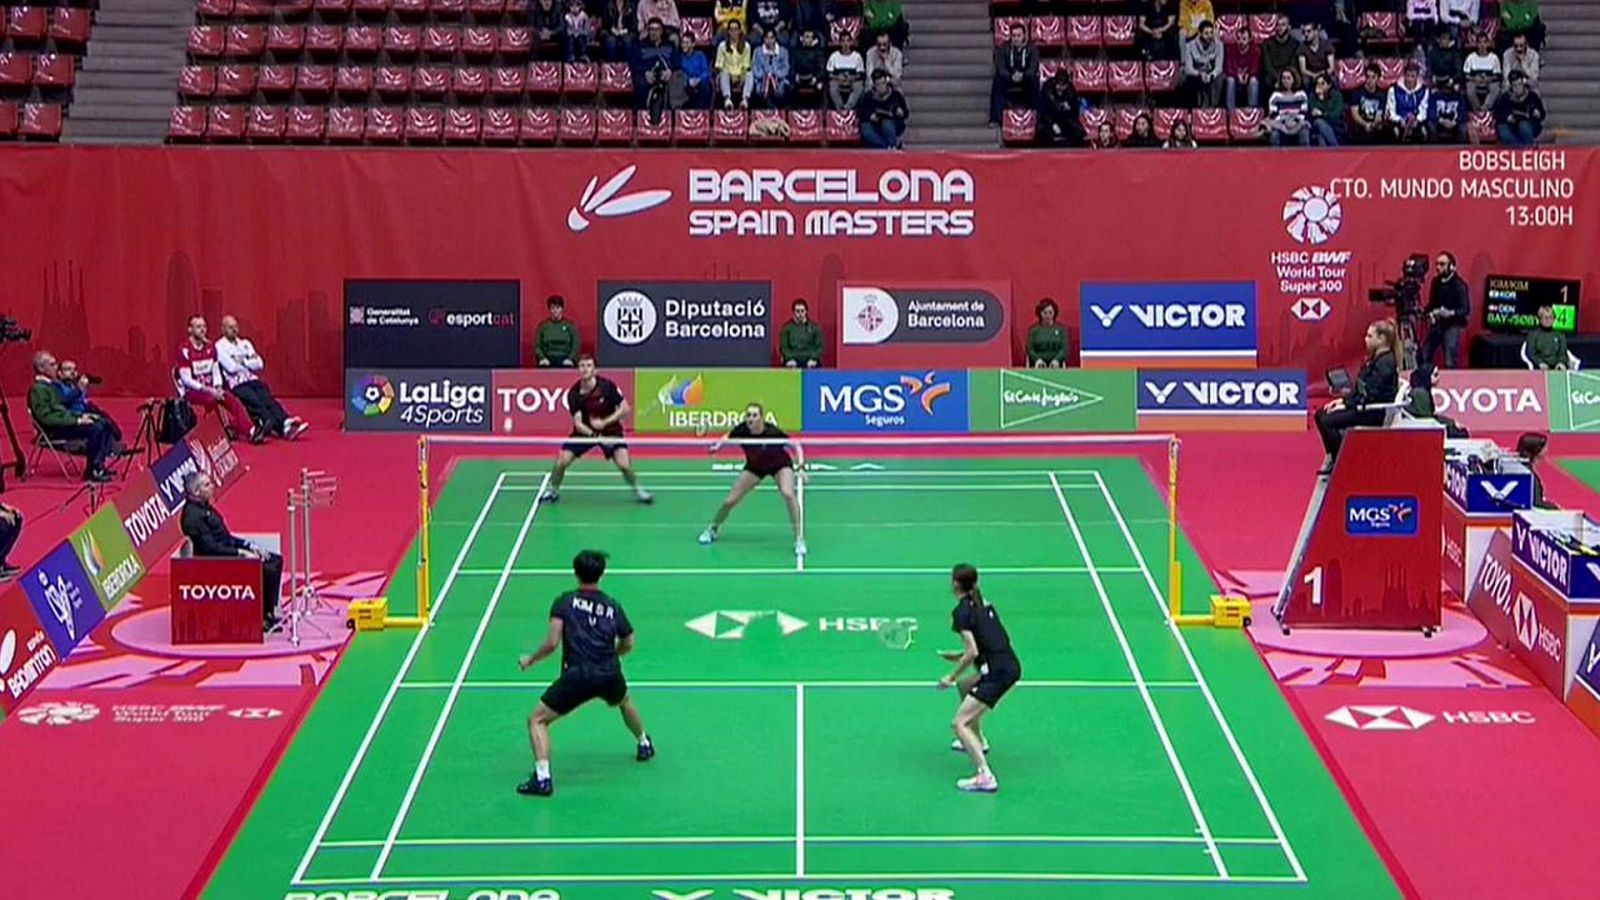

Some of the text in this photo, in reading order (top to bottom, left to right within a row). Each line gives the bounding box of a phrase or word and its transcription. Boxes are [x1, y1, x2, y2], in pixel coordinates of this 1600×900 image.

[689, 169, 974, 202] BARCELONA
[689, 209, 974, 236] SPAIN MASTERS
[1271, 251, 1351, 264] HSBC BWF
[1276, 265, 1346, 278] World Tour
[1280, 280, 1343, 294] Super 300
[1560, 285, 1569, 303] 1
[665, 300, 765, 320] Diputació
[908, 300, 985, 312] Ajuntament de
[1129, 304, 1246, 328] VICTOR
[908, 314, 985, 328] Barcelona
[1557, 308, 1568, 327] 4
[665, 320, 765, 338] Barcelona
[400, 380, 486, 406] LaLiga
[819, 385, 905, 412] MGS
[1183, 381, 1300, 405] VICTOR
[1432, 388, 1542, 413] OYOTA
[400, 405, 484, 427] 4Sports
[864, 414, 905, 426] Seguros
[124, 492, 171, 547] TOYOTA
[1349, 507, 1391, 521] MGS
[1527, 531, 1569, 586] VICTOR
[179, 585, 256, 600] TOYOTA
[1304, 567, 1325, 605] 1
[1538, 622, 1562, 663] HSBC
[1443, 711, 1536, 724] HSBC
